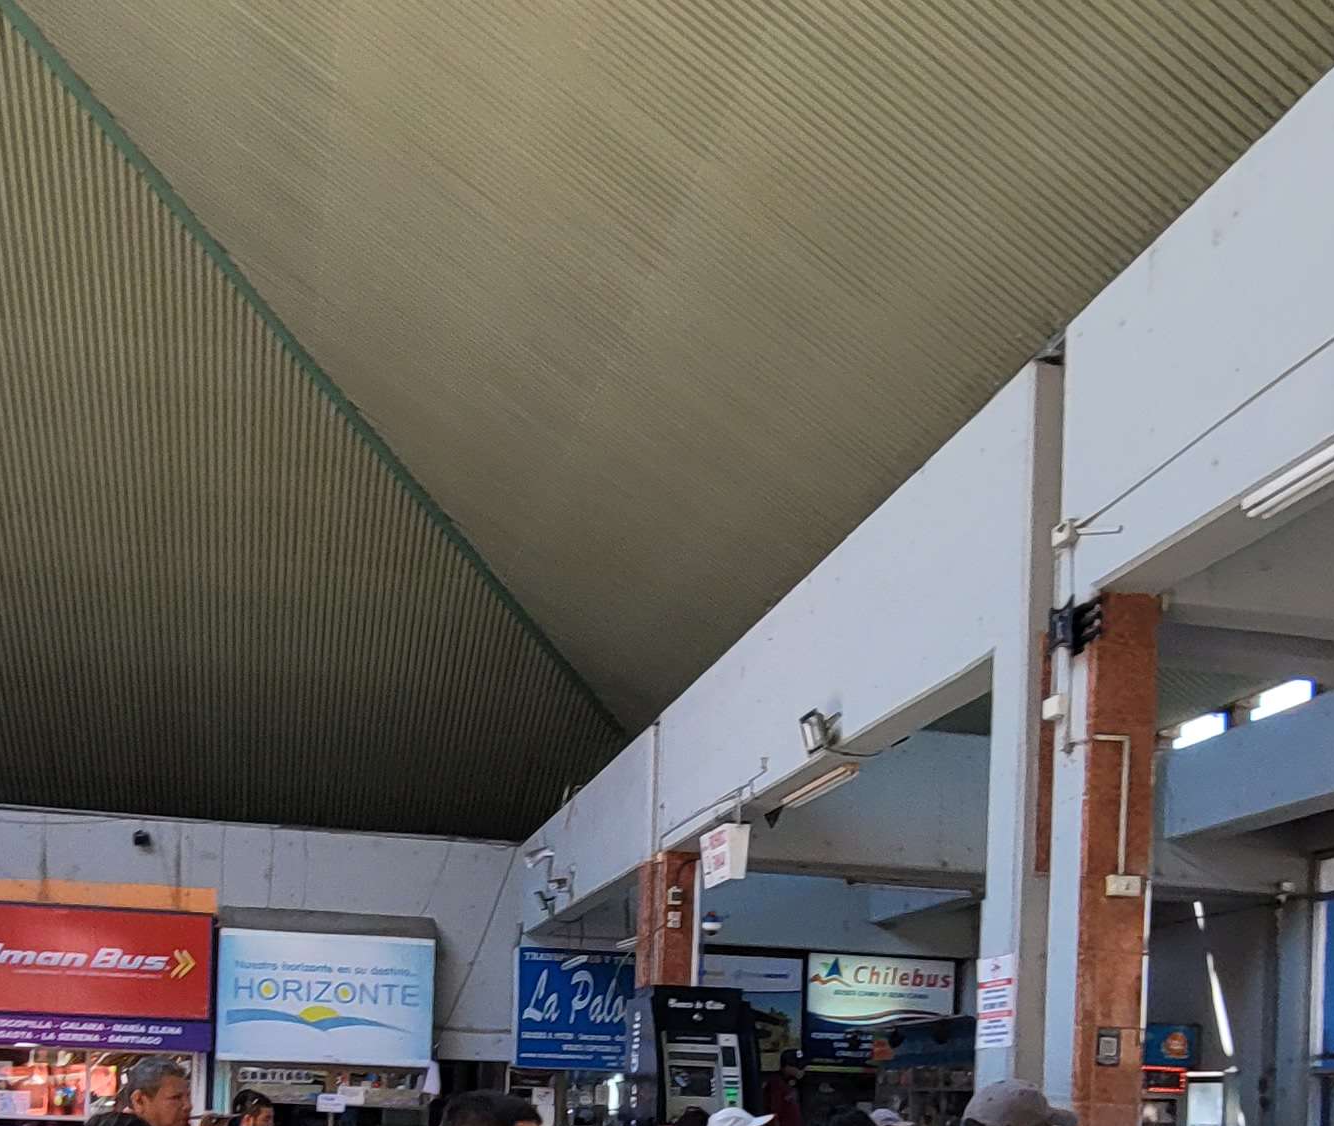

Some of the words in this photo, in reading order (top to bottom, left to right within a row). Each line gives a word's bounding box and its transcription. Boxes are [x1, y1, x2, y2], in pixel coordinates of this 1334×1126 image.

[90, 947, 170, 971] Bus
[853, 965, 952, 988] Chilebus
[234, 976, 420, 1007] HORIZONTE
[522, 968, 560, 1022] La
